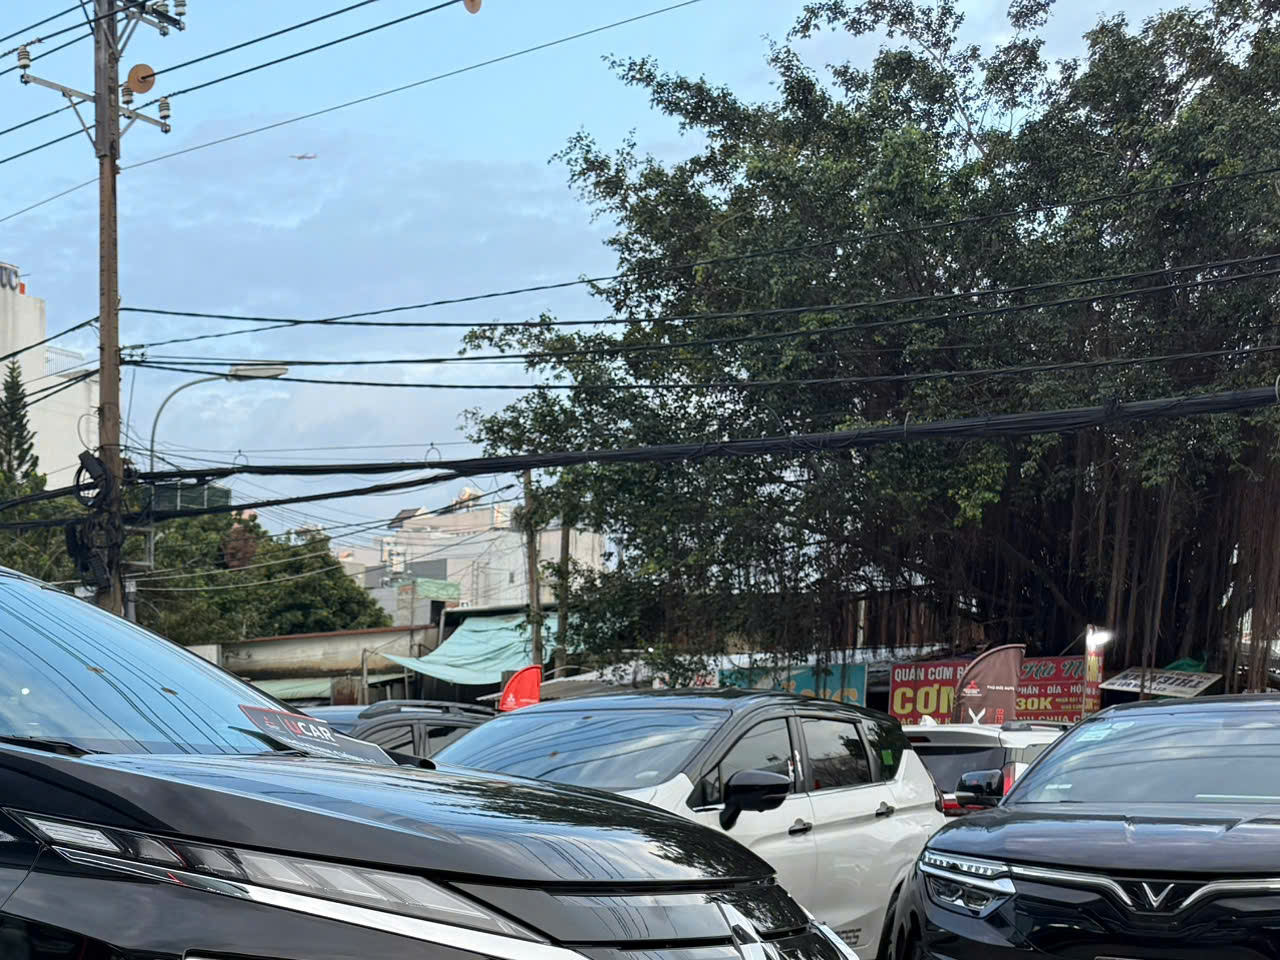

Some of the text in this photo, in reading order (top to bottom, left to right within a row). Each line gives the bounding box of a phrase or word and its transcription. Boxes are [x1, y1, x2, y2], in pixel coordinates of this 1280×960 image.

[894, 666, 924, 682] QUÁN
[928, 665, 953, 681] CƠM
[1016, 696, 1053, 710] 30K
[284, 718, 337, 742] UCAR
